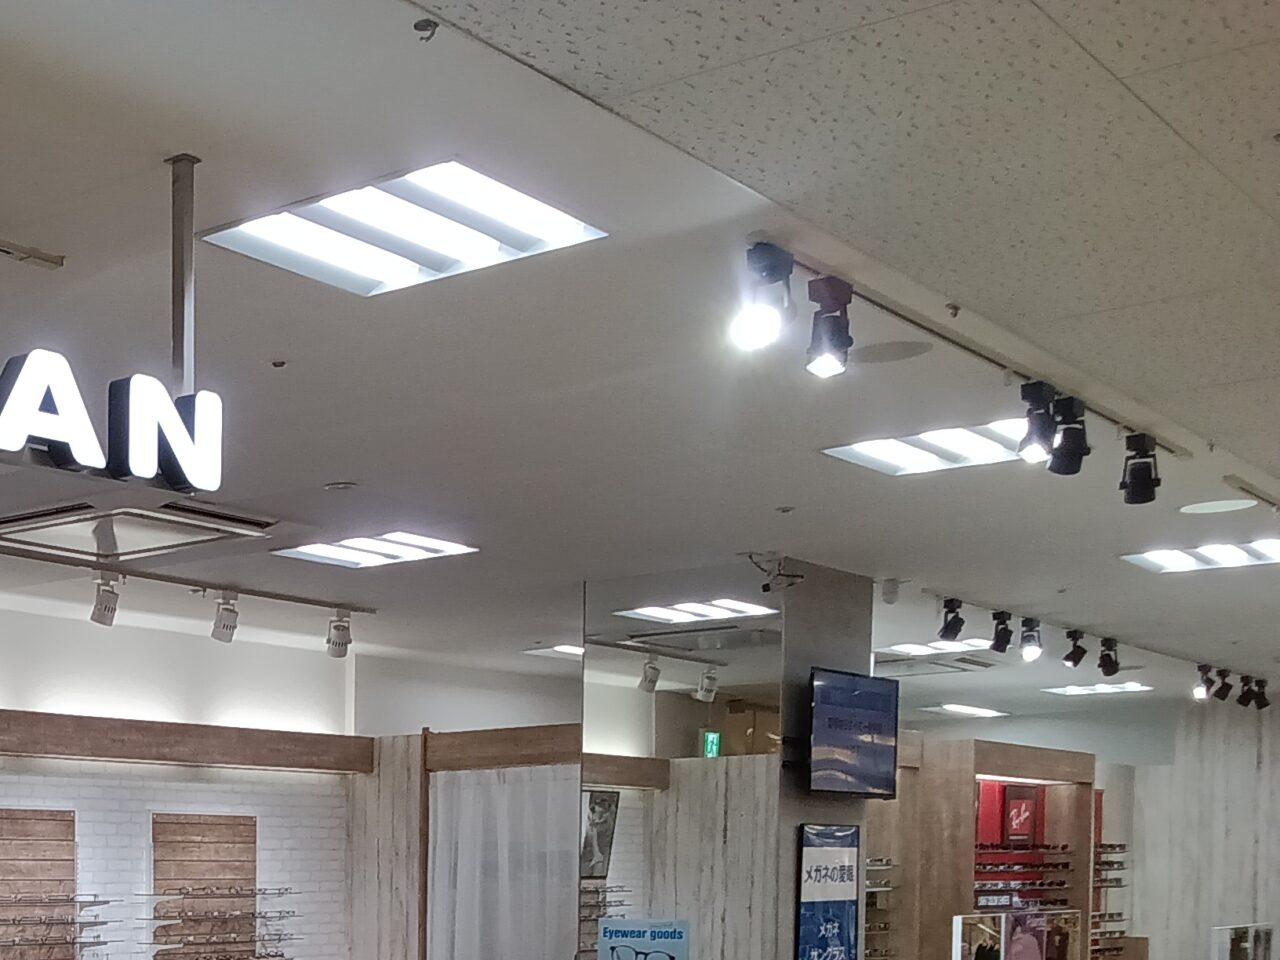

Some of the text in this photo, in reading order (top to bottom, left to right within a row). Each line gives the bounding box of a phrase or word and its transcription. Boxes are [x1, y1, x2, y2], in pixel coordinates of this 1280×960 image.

[804, 865, 855, 883] メガネの愛眼
[603, 926, 684, 941] Eyewear goods
[818, 922, 840, 938] メガネ
